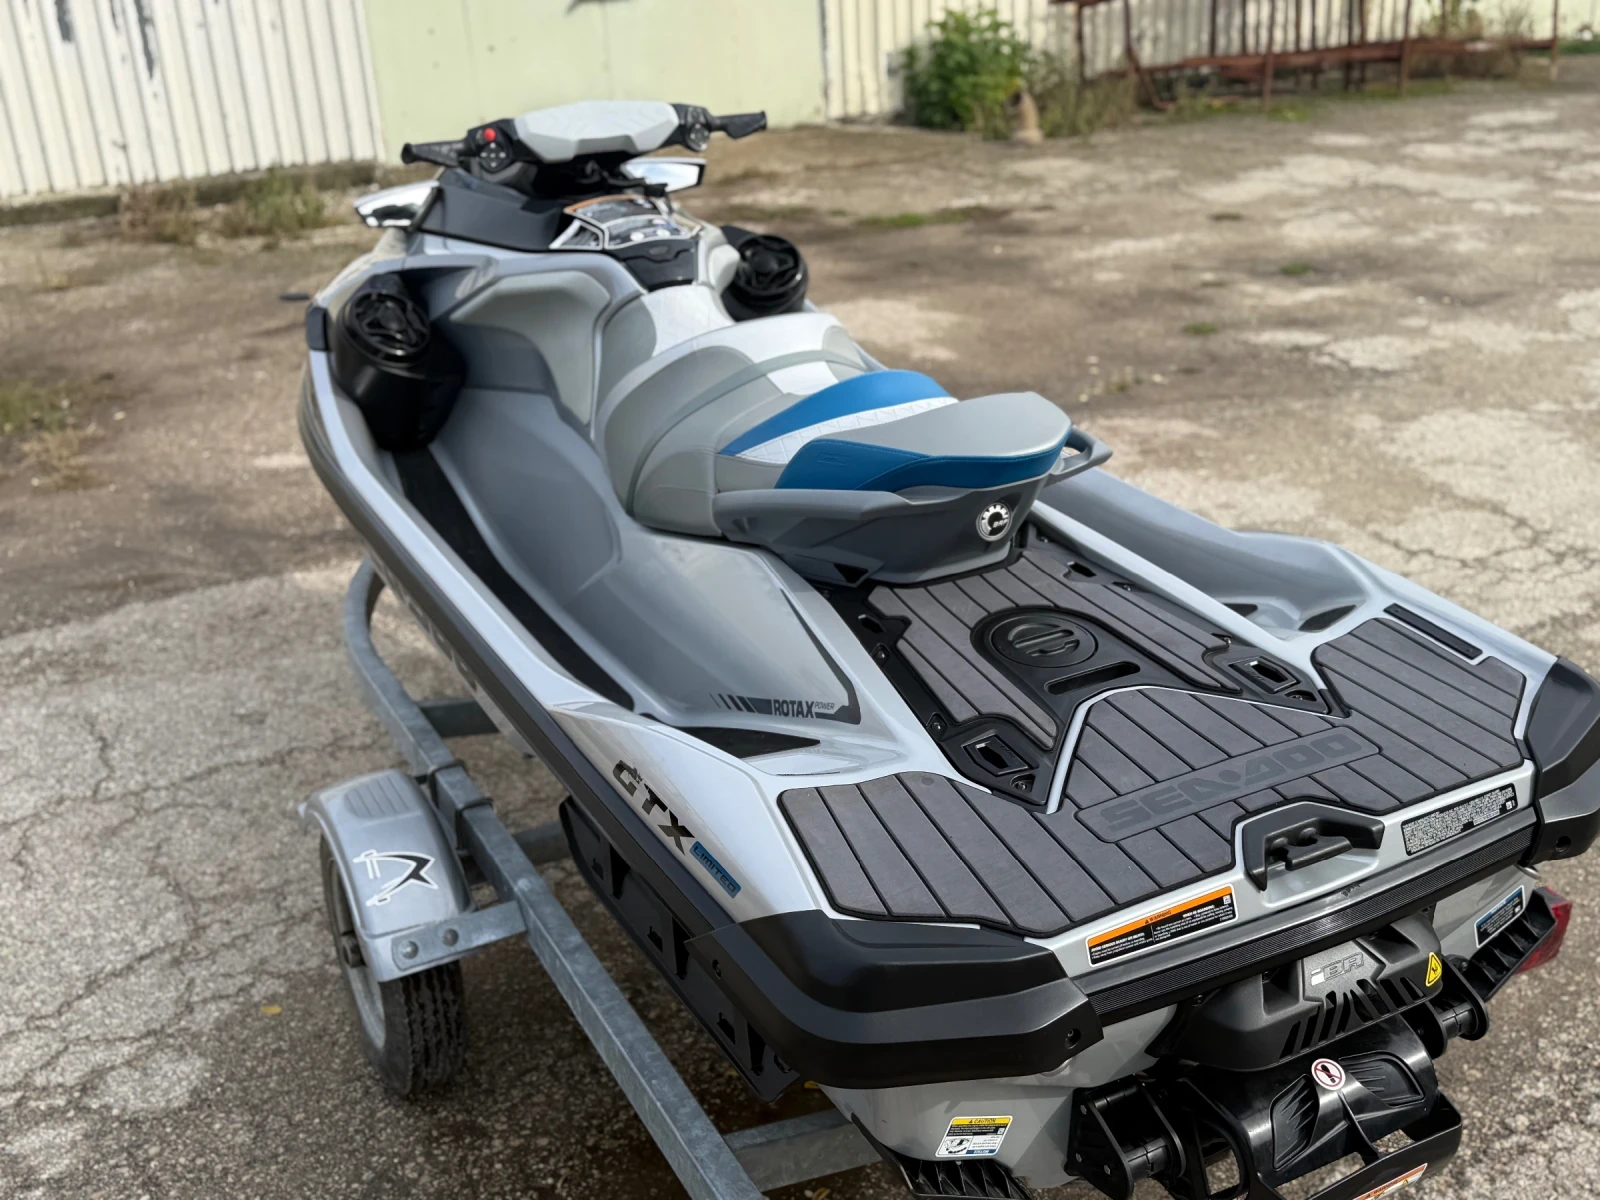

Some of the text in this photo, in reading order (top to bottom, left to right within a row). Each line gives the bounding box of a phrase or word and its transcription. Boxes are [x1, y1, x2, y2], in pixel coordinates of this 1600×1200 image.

[773, 699, 835, 718] ROTAX POWER
[612, 759, 696, 856] GTX
[693, 845, 737, 893] LIMITED
